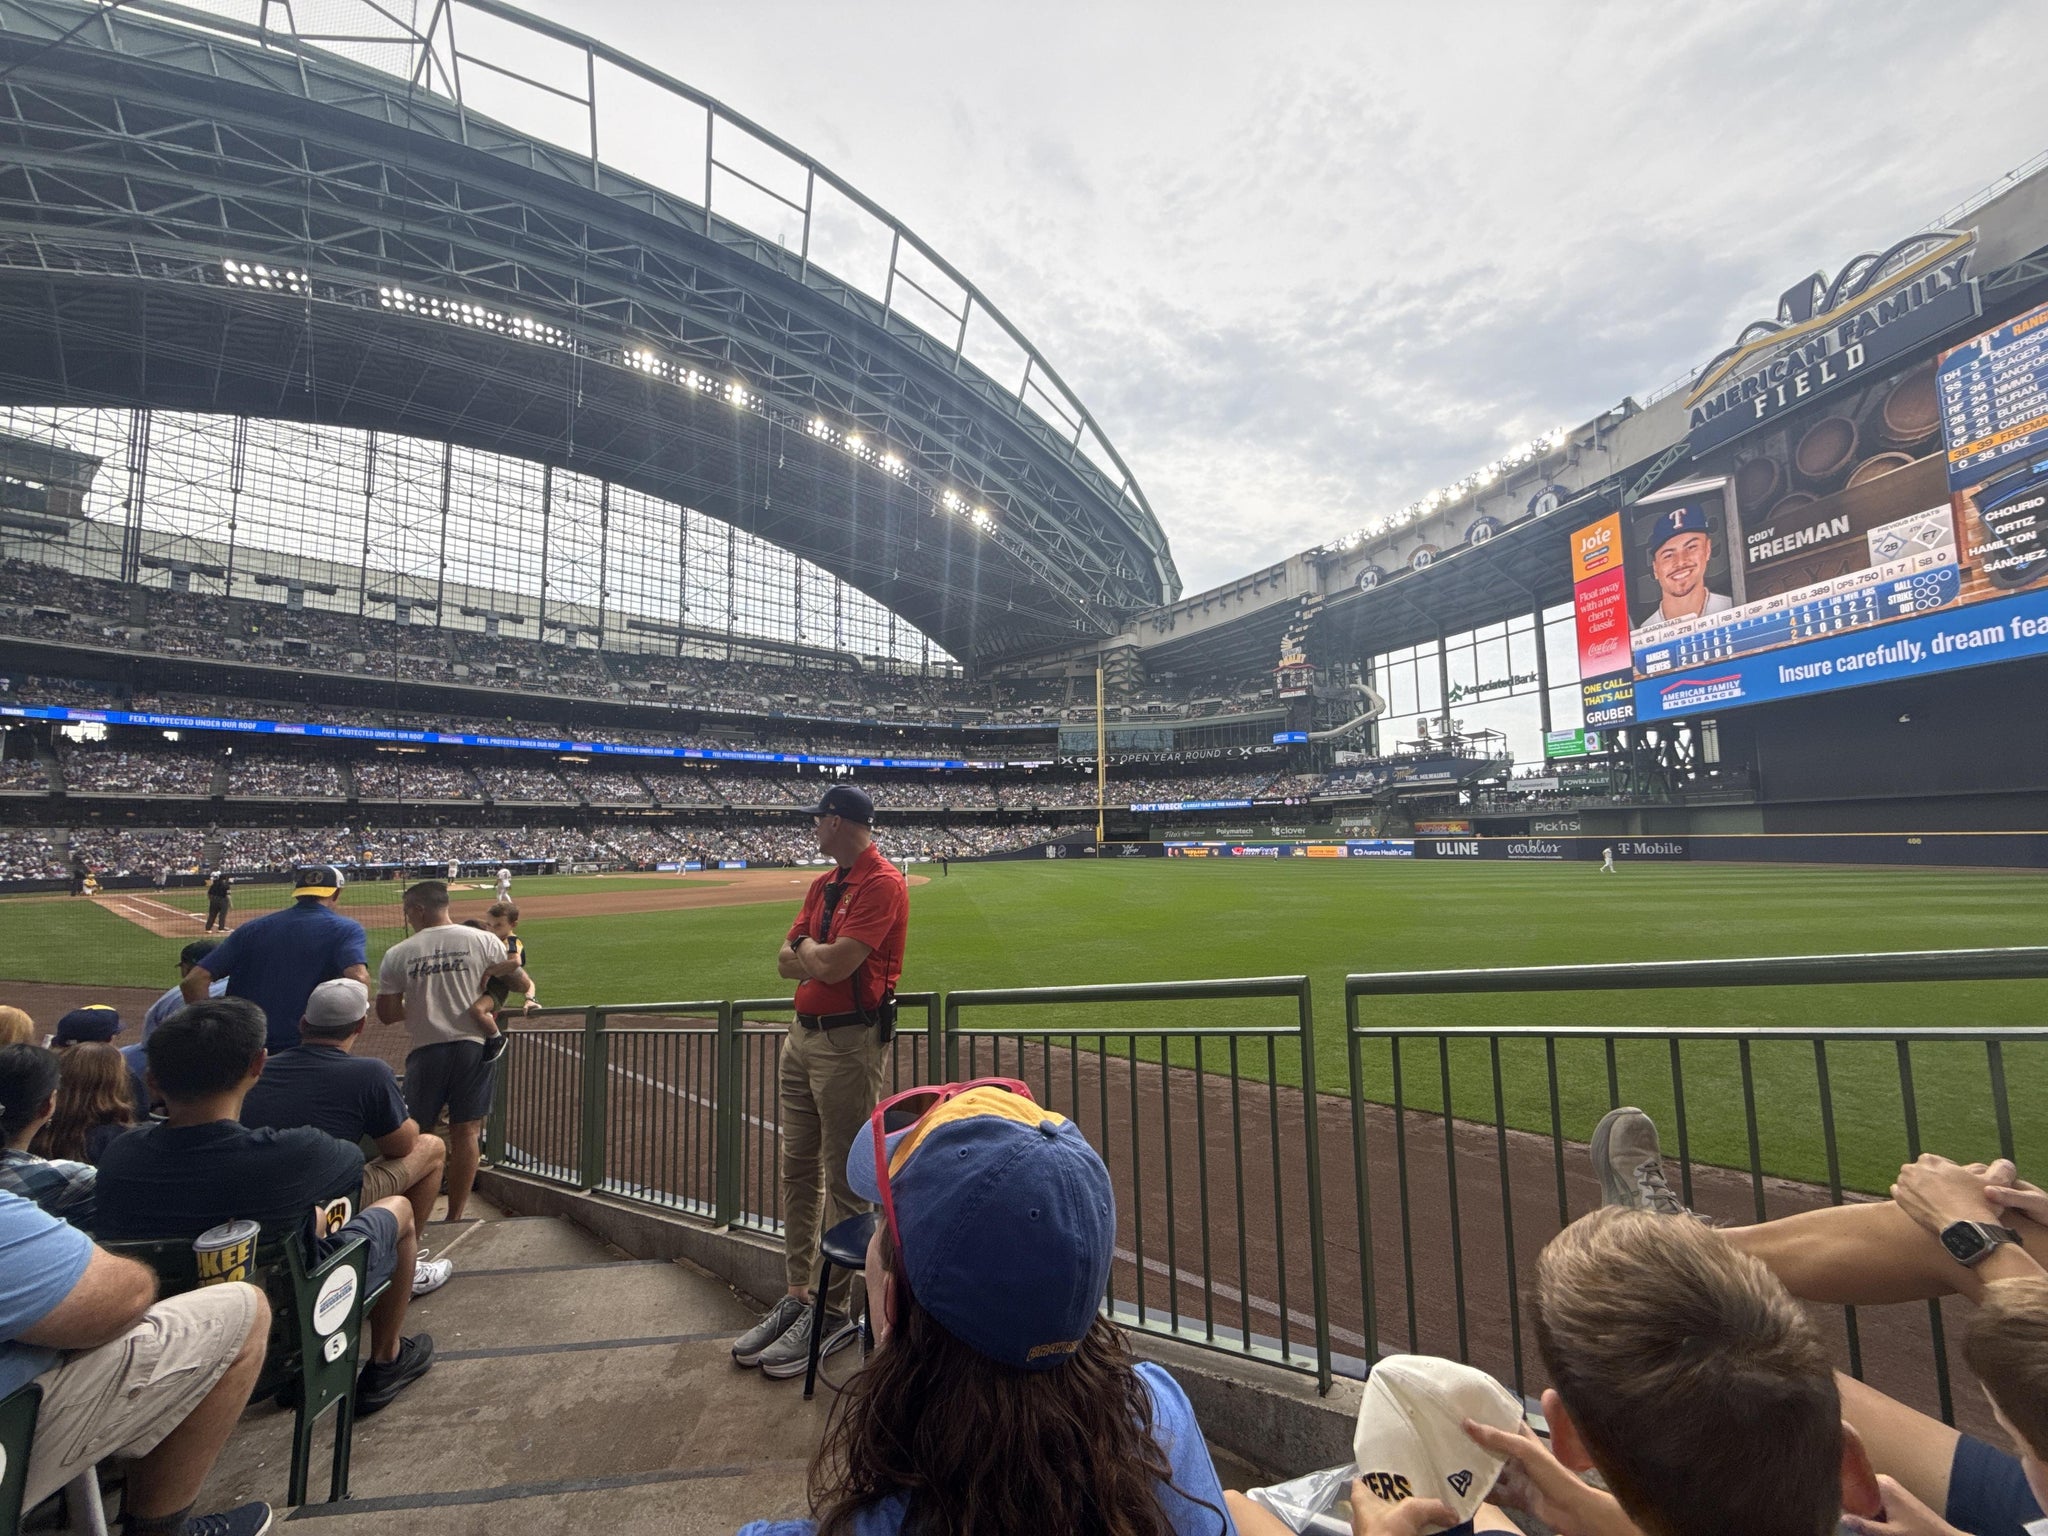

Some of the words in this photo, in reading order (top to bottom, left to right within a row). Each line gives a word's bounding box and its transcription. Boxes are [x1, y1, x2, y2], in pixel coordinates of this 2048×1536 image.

[1690, 335, 1828, 430] AMERICAN
[1837, 249, 1976, 346] FAMILY
[1970, 330, 2000, 358] T
[1944, 368, 1961, 382] DH
[1970, 361, 1980, 370] 3
[1945, 380, 1962, 393] SS
[1972, 372, 1980, 381] 5
[1992, 346, 2040, 373] SEAGER
[1754, 342, 1866, 419] FIELD
[1947, 392, 1962, 404] LF
[1970, 382, 1986, 394] 36
[1949, 403, 1964, 415] RF
[1971, 393, 1987, 405] 24
[1994, 373, 2034, 396] NIMMO
[1950, 414, 1966, 426] 2B
[1972, 405, 1989, 416] 20
[1996, 383, 2038, 408] DURAN
[1952, 425, 1966, 436] 1B
[1976, 416, 1989, 428] 21
[1997, 392, 2047, 419] BURGER
[1952, 435, 1968, 448] CF
[1975, 426, 1992, 439] 32
[1999, 405, 2048, 430] CARTER
[1958, 459, 1968, 469] C
[1978, 450, 1995, 462] 35
[2002, 436, 2030, 454] DIAZ
[1977, 438, 1994, 450] 39
[1985, 496, 2045, 521] CHOURIO
[1669, 508, 1686, 529] T
[1878, 519, 1909, 533] PREVIOUS
[1910, 509, 1941, 523] AT-BATS
[1995, 515, 2036, 534] ORTIZ
[1473, 526, 1492, 543] 44
[1580, 527, 1611, 553] Joie
[1748, 527, 1775, 545] CODY
[1750, 514, 1850, 563] FREEMAN
[1922, 530, 1937, 540] F7
[1968, 530, 2037, 556] HAMILTON
[1884, 541, 1898, 553] 2B
[1414, 553, 1431, 568] 42
[1983, 548, 2047, 573] SÁNCHEZ
[1362, 575, 1376, 590] 34
[1579, 589, 1599, 603] Float
[1599, 581, 1620, 595] away
[1894, 580, 1912, 592] BALL
[1580, 601, 1597, 613] with
[1604, 594, 1620, 606] new
[1663, 631, 1674, 639] AVG
[1677, 626, 1692, 634] .278
[1748, 606, 1763, 615] OBP
[1767, 599, 1784, 609] .361
[1791, 593, 1807, 603] SLG
[1809, 586, 1830, 598] .389
[1836, 580, 1854, 590] OPS
[1856, 572, 1879, 585] .750
[1887, 568, 1894, 576] R
[1898, 564, 1905, 572] 7
[1919, 557, 1933, 566] SB
[1937, 553, 1946, 561] 0
[1888, 590, 1914, 605] STRIKE
[1588, 607, 1614, 623] cherry
[1900, 602, 1914, 613] OUT
[1589, 618, 1615, 634] classic
[1646, 649, 1670, 663] RANGERS
[1714, 636, 1719, 646] 0
[1725, 634, 1731, 643] 2
[1790, 617, 1796, 626] 4
[1804, 613, 1810, 623] 6
[1834, 605, 1840, 616] 6
[1849, 601, 1856, 612] 2
[1865, 597, 1872, 608] 2
[1646, 660, 1671, 674] BREWERS
[1682, 656, 1687, 666] 2
[1692, 654, 1697, 663] 0
[1703, 651, 1709, 660] 0
[1715, 648, 1720, 658] 0
[1726, 645, 1732, 655] 0
[1790, 629, 1798, 639] 2
[1805, 626, 1812, 636] 4
[1820, 622, 1826, 633] 0
[1835, 618, 1842, 629] 8
[1850, 615, 1858, 625] 2
[1778, 660, 1833, 684] Insure
[1836, 640, 1927, 674] carefully,
[1931, 625, 2005, 655] dream
[1463, 675, 1514, 696] Associated
[1515, 671, 1538, 685] Bank
[1584, 683, 1602, 694] ONE
[1603, 678, 1632, 690] CALL...
[1663, 687, 1705, 701] AMERICAN
[1708, 680, 1740, 693] FAMILY
[1584, 693, 1613, 706] THAT'S
[1614, 688, 1633, 700] ALL!
[1668, 691, 1734, 707] INSURANCE
[149, 717, 193, 726] PROTECTED
[238, 722, 257, 730] ROOF
[1586, 705, 1633, 724] GRUBER
[338, 729, 373, 737] PROTECTED
[1061, 756, 1073, 764] X
[1120, 754, 1148, 763] OPEN
[1154, 753, 1180, 762] YEAR
[1186, 750, 1221, 760] ROUND
[1239, 747, 1252, 755] X
[1130, 803, 1156, 811] DON'T
[1216, 828, 1253, 837] Polymatech
[1535, 822, 1558, 832] Pick
[1436, 842, 1478, 855] ULINE
[1507, 840, 1561, 854] carbliss
[1618, 842, 1630, 854] T
[1634, 842, 1682, 854] Mobile
[333, 1339, 340, 1354] 5
[1362, 1472, 1414, 1501] ERS
